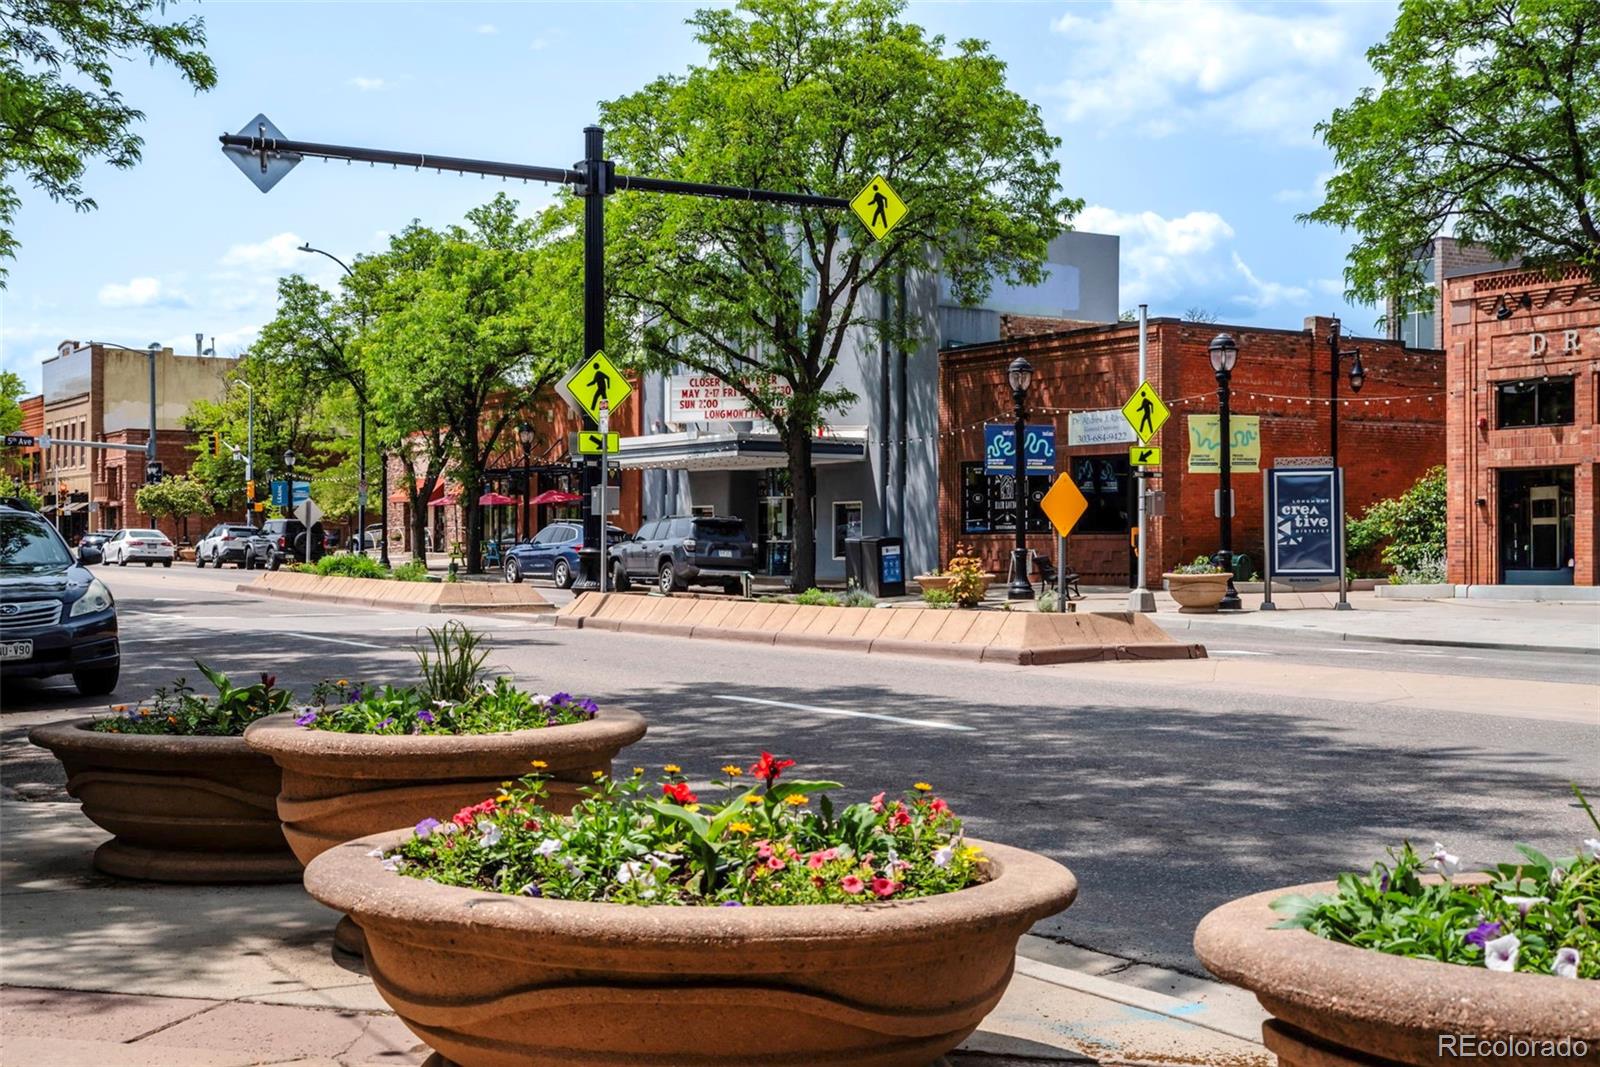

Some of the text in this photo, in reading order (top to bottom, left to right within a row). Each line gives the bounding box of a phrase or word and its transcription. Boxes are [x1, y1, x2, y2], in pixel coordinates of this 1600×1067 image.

[1529, 328, 1600, 356] DR
[689, 377, 721, 388] CLOSER
[681, 389, 700, 398] MAY
[704, 388, 720, 398] 2-17
[722, 387, 737, 397] FRI
[679, 399, 718, 409] SUN 2:00
[704, 409, 748, 419] LONGMONT
[18, 438, 33, 446] Ave
[1294, 514, 1329, 528] tive
